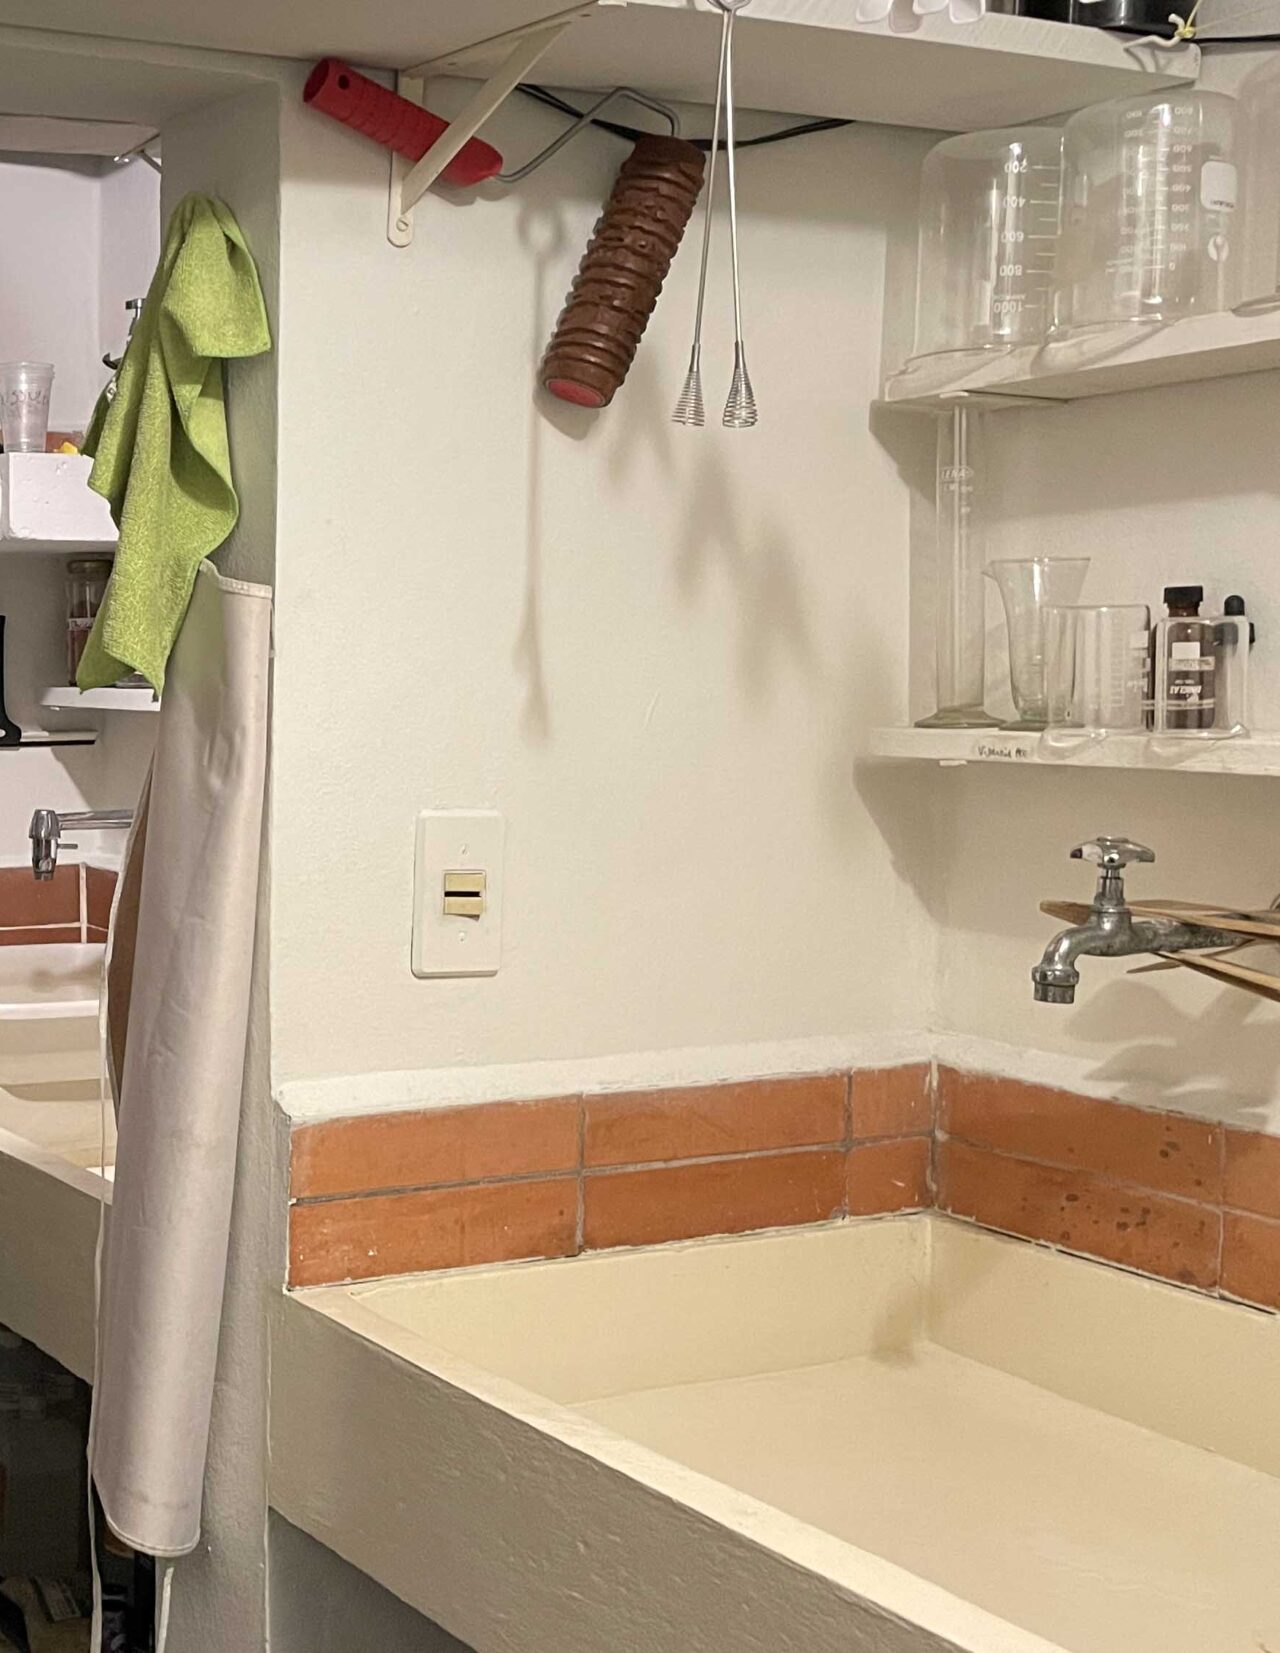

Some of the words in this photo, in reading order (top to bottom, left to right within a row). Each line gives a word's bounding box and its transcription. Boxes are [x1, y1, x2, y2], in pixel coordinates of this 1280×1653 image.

[1003, 196, 1026, 208] 400
[1001, 231, 1024, 242] 600
[999, 264, 1023, 276] 800
[993, 300, 1024, 314] 1000
